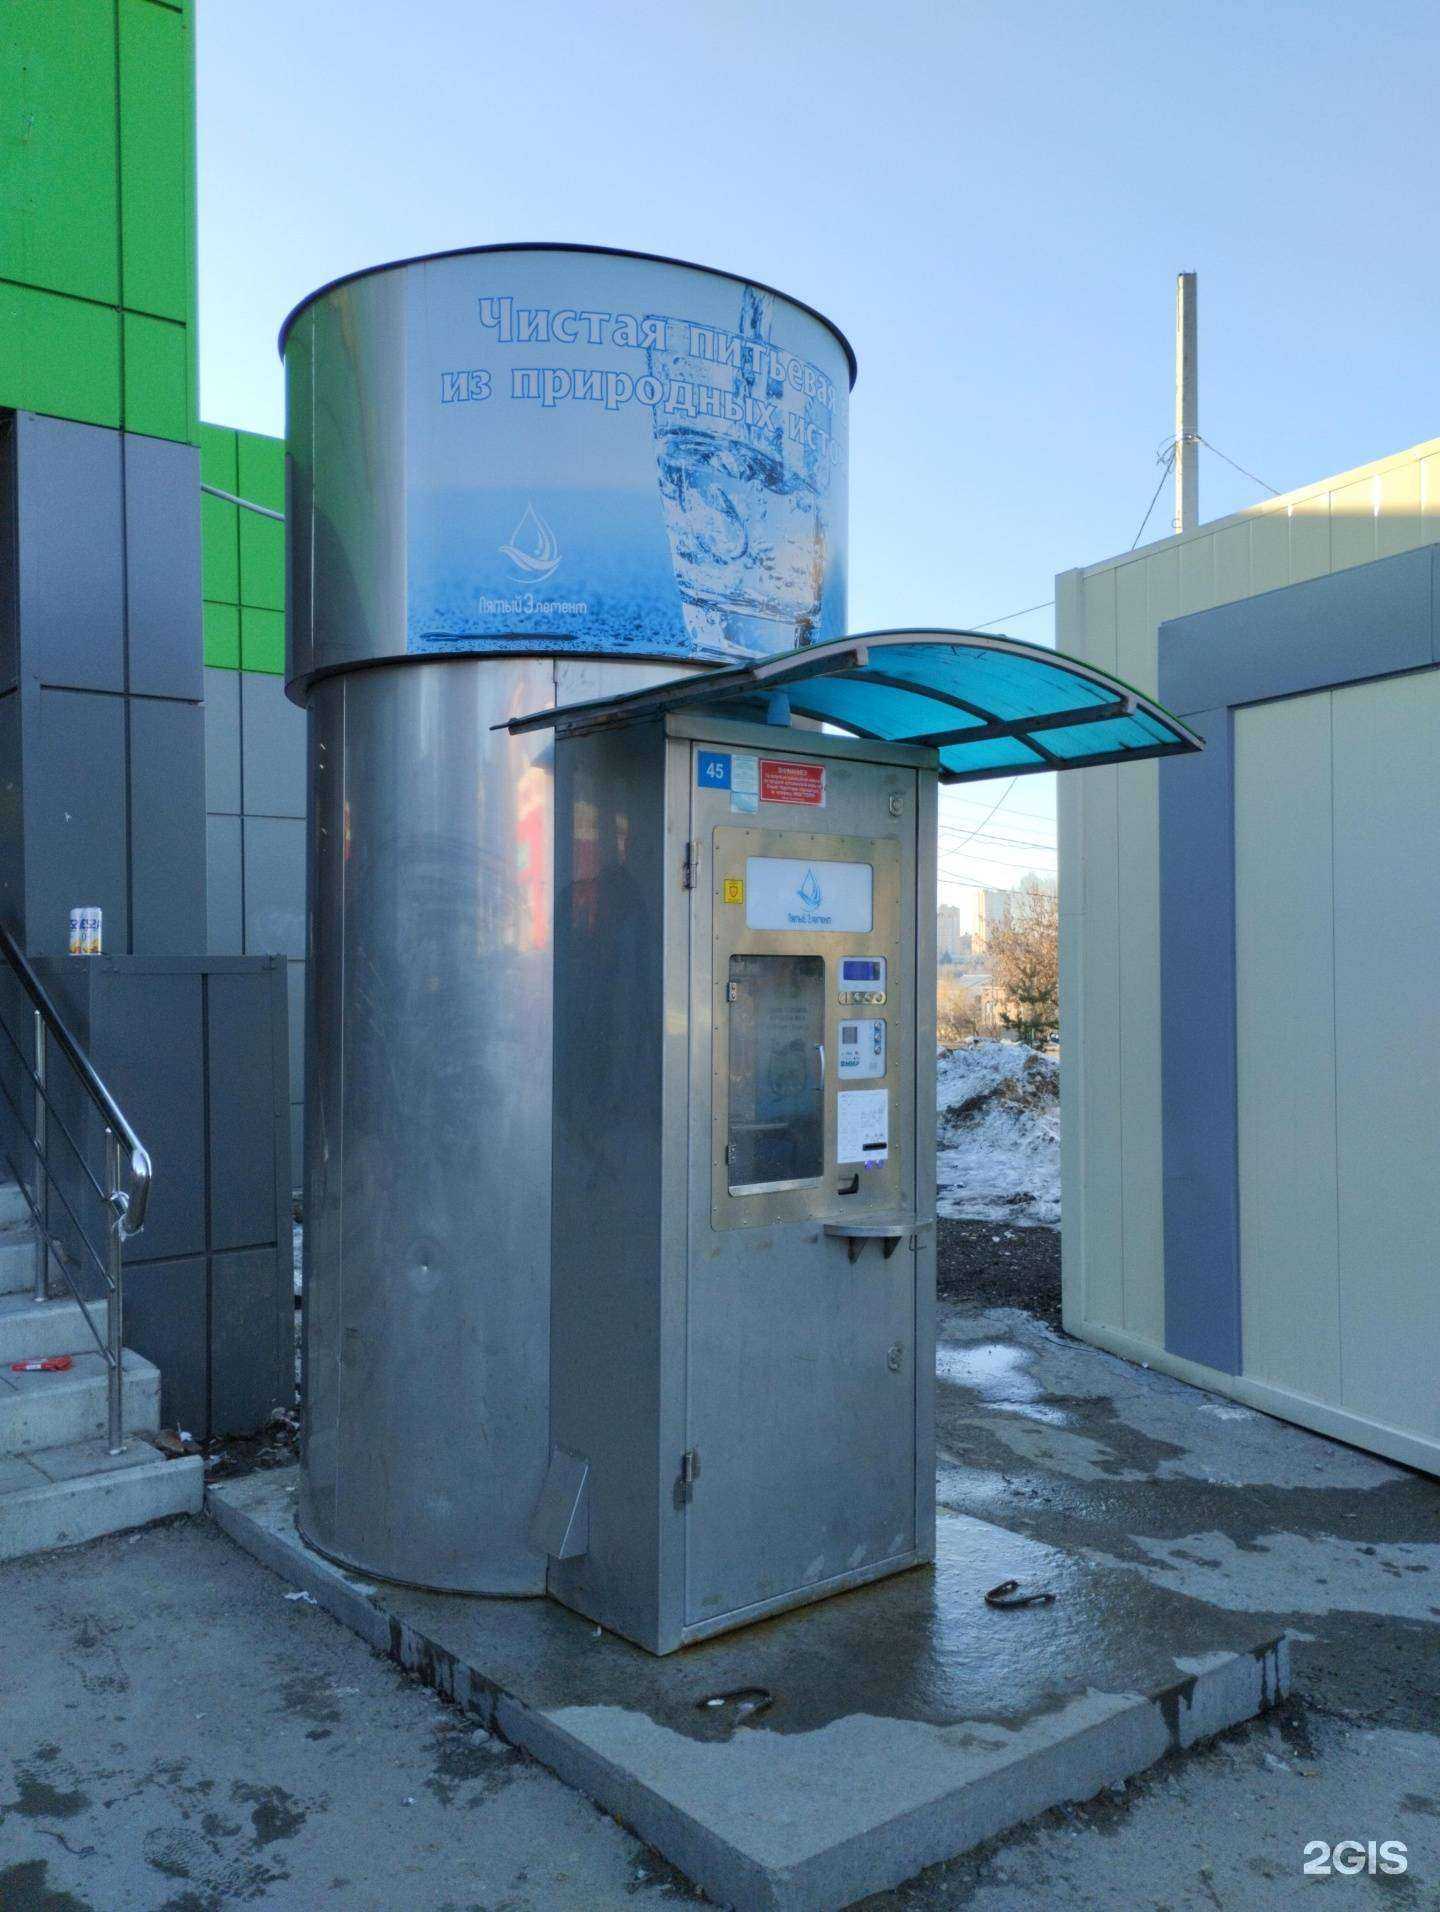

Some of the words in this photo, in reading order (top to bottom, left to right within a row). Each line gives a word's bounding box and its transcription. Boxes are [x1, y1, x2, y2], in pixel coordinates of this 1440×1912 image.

[478, 296, 668, 352] Чистая
[441, 368, 492, 403] из
[511, 367, 778, 434] природных
[706, 762, 724, 779] 45
